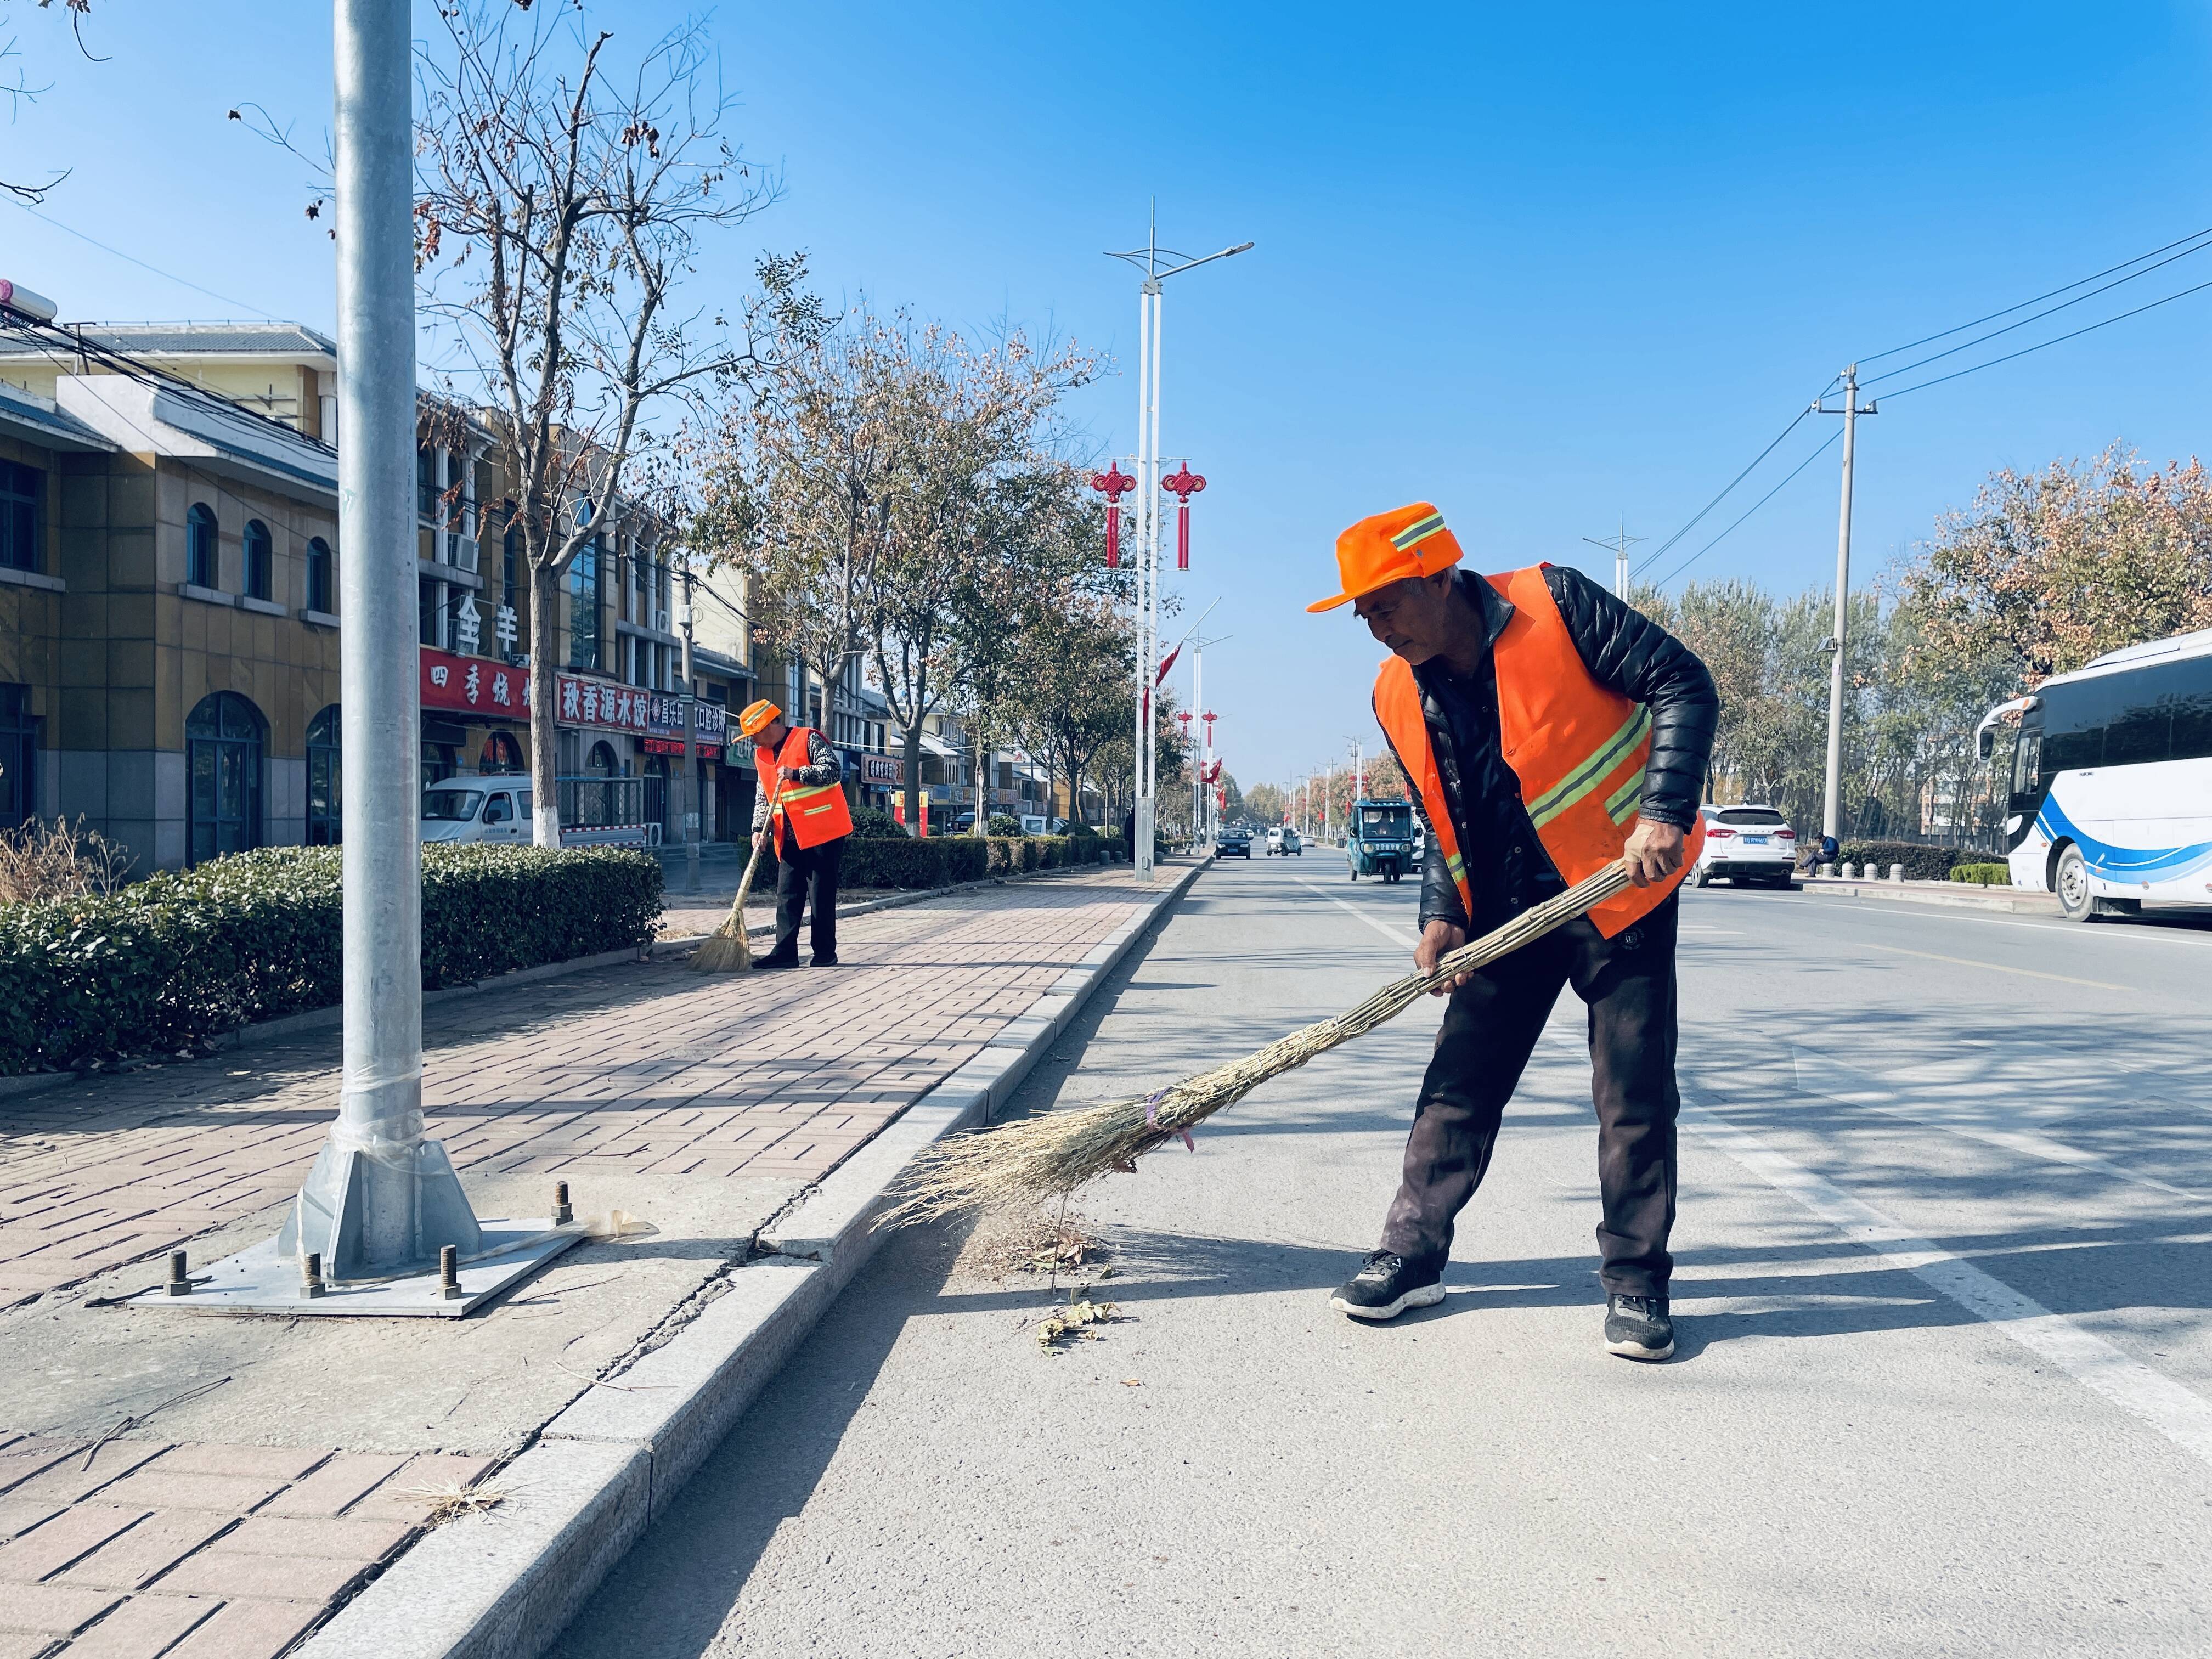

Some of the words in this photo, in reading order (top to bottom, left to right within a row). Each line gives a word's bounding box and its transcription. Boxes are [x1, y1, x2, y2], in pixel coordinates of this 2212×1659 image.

[563, 681, 647, 728] 秋香源水饺
